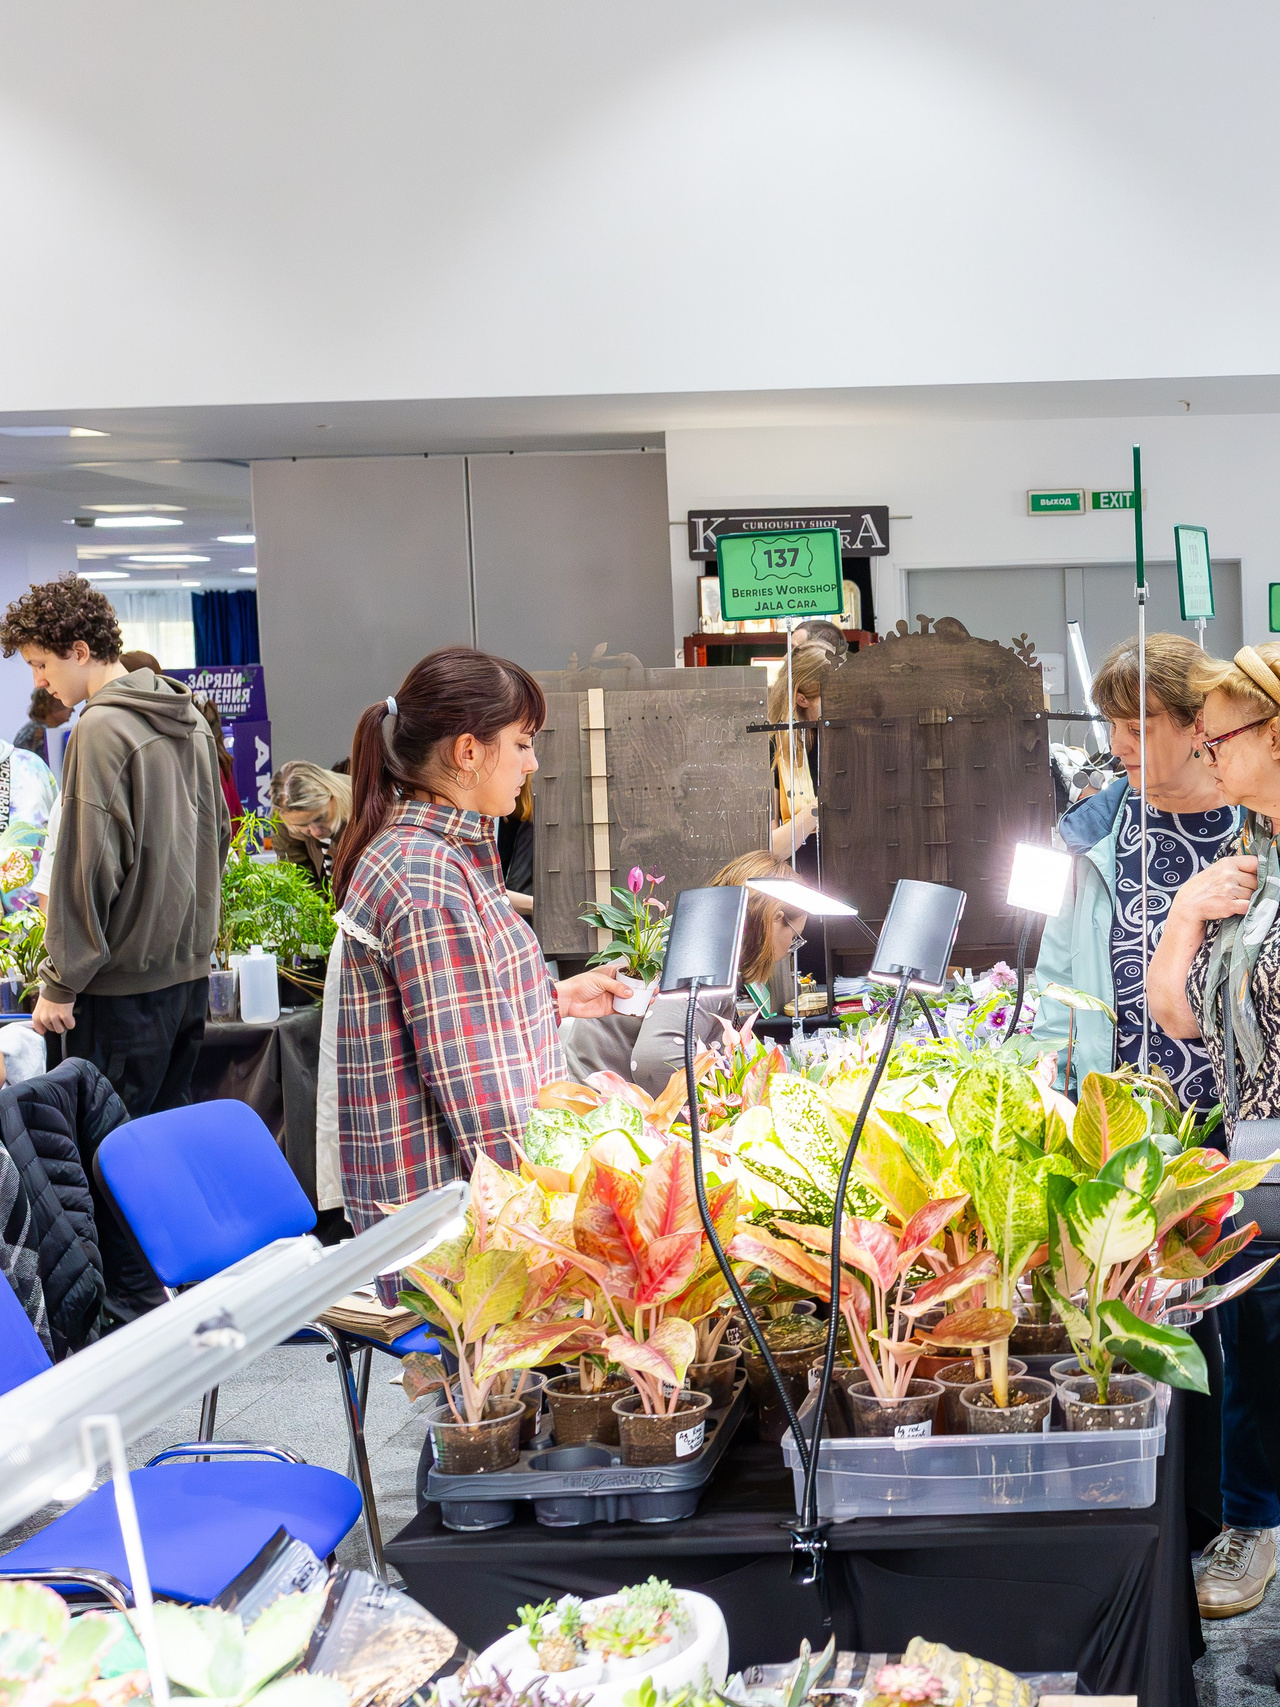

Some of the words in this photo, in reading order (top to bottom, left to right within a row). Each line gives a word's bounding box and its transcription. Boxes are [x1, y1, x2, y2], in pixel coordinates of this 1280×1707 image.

[1040, 497, 1072, 506] ВЫХОД
[1100, 492, 1133, 508] EXIT
[742, 520, 807, 530] CURIOUSITY
[809, 520, 838, 528] SHOP
[763, 547, 800, 569] 137
[731, 588, 774, 598] BERRIES
[776, 584, 837, 595] WORKSHOP
[754, 601, 784, 611] JALA
[786, 599, 818, 609] CARA
[187, 672, 243, 689] ЗАРЯДИ
